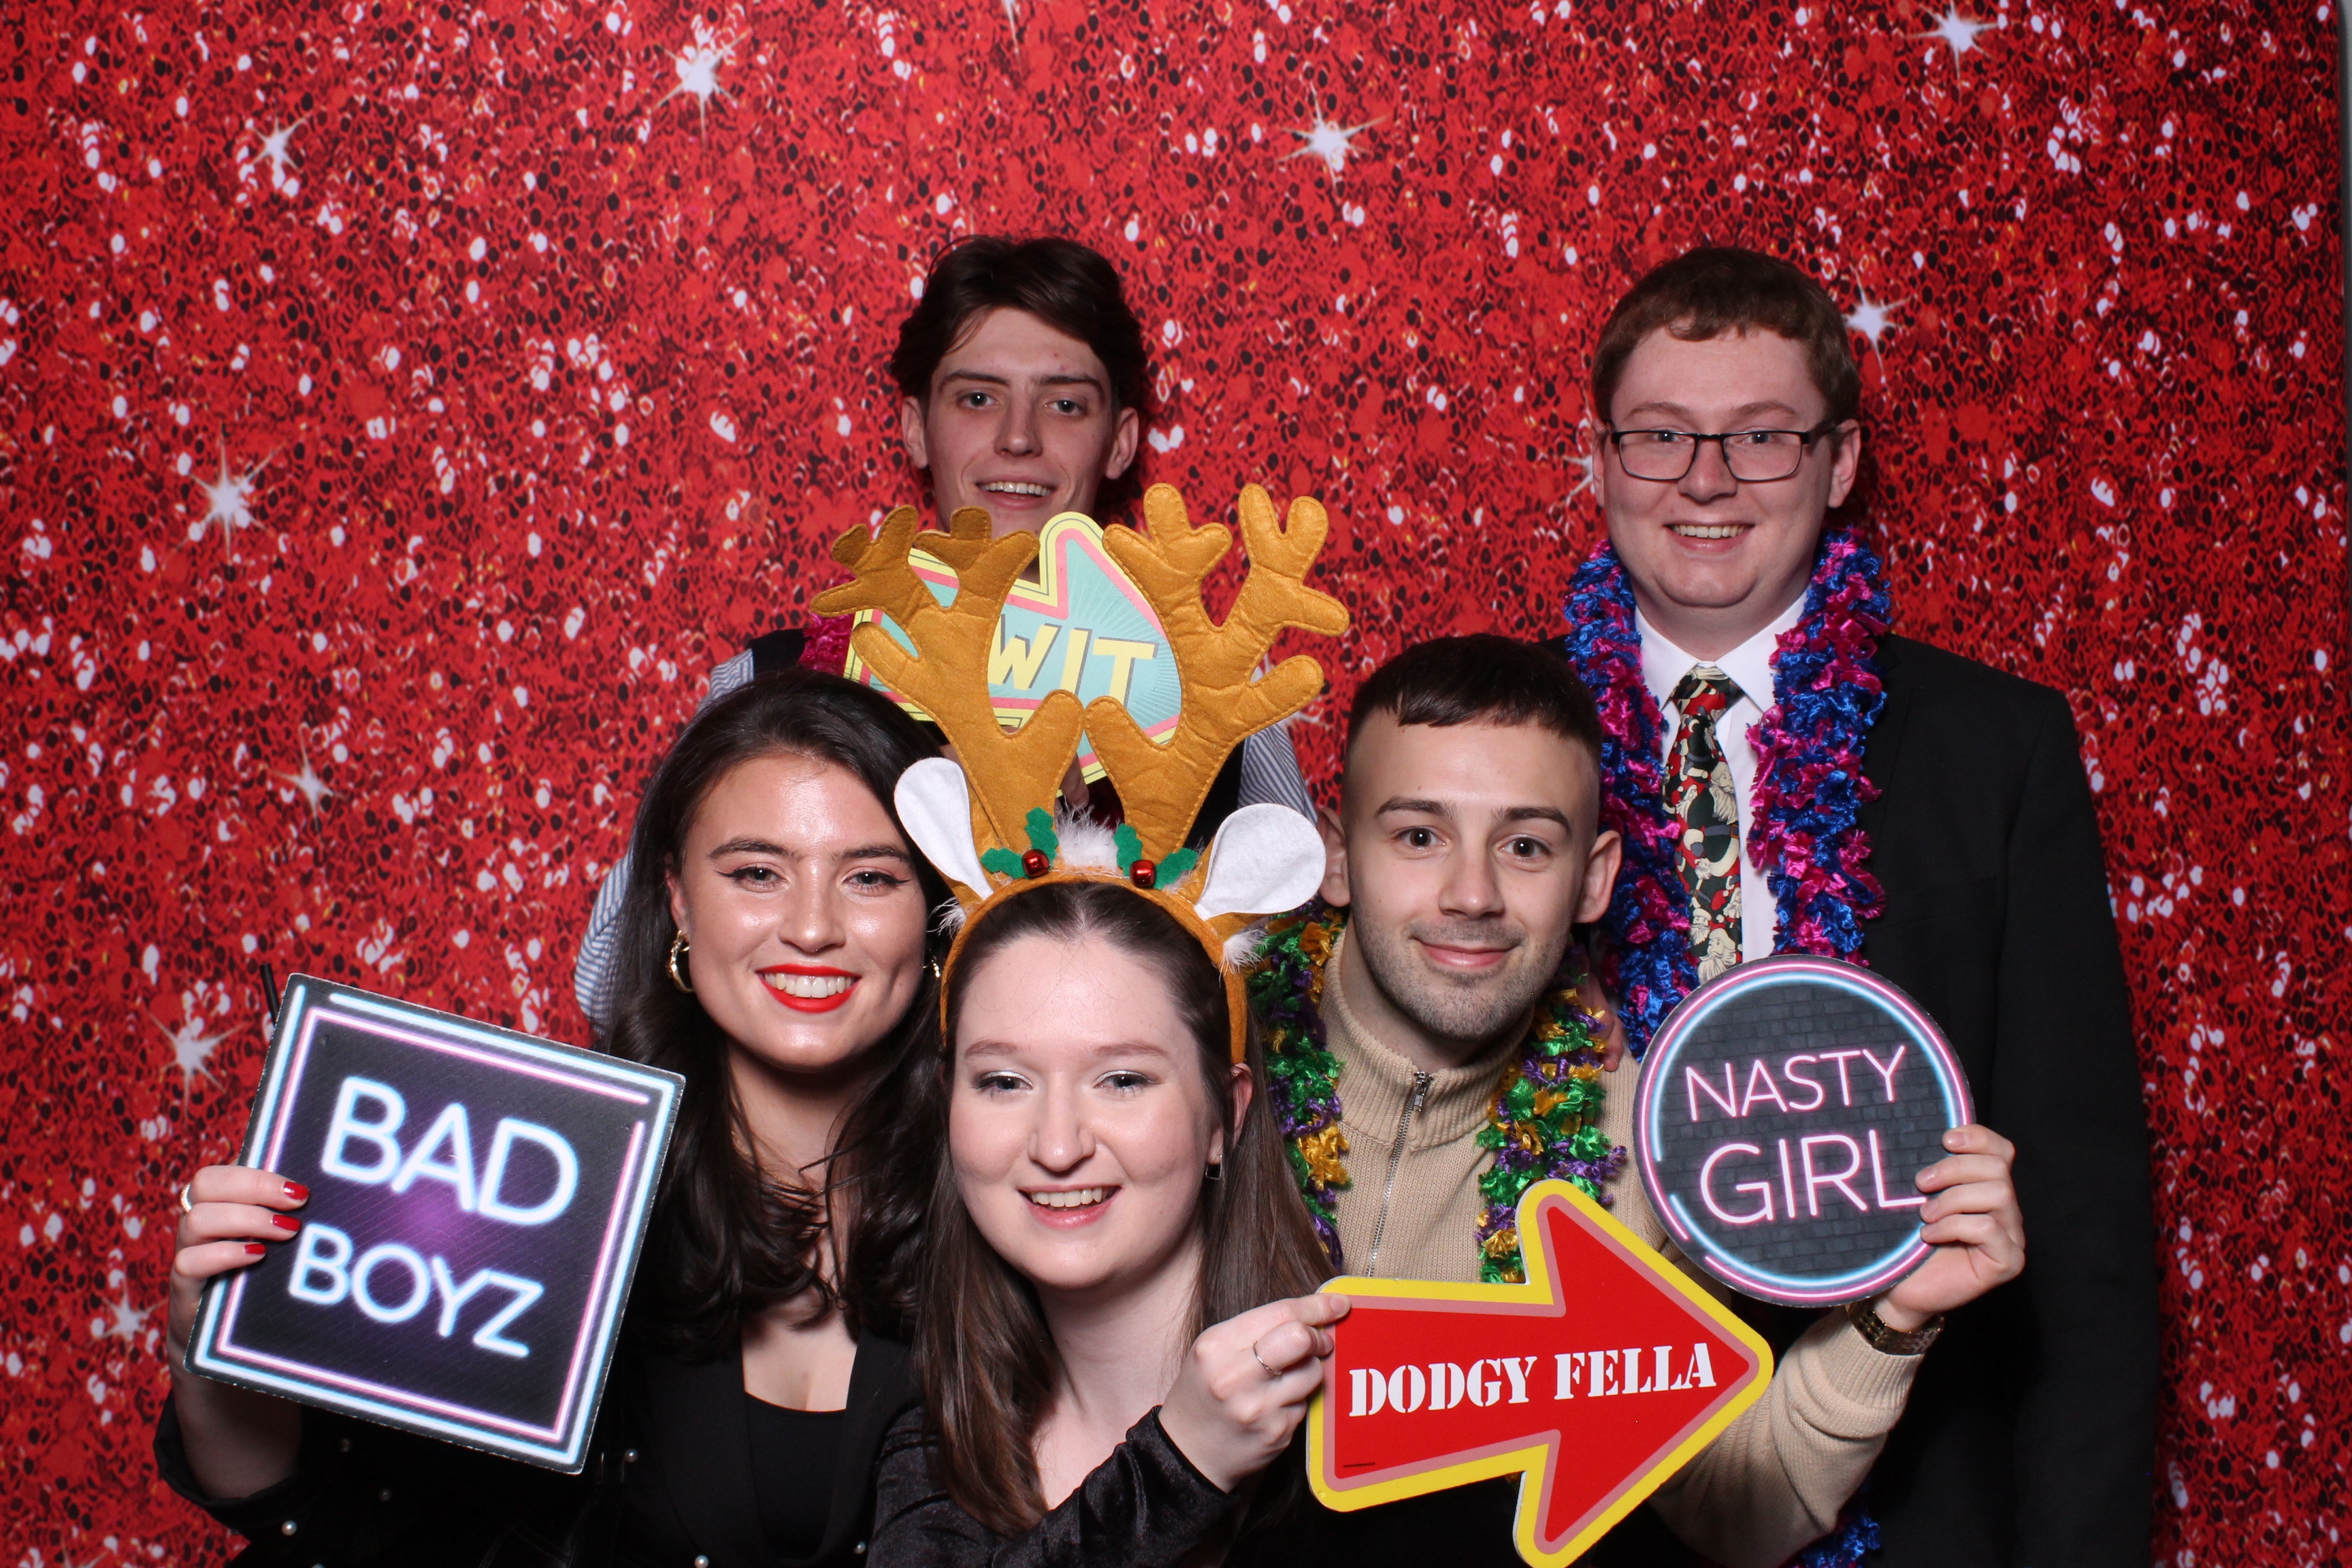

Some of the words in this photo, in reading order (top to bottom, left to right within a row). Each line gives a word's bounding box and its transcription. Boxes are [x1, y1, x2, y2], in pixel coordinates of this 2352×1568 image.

[987, 613, 1160, 709] WIT
[1684, 1044, 1907, 1123] NASTY
[320, 1074, 580, 1225] BAD
[1700, 1128, 1927, 1225] GIRL
[287, 1222, 544, 1358] BOYZ
[1348, 1355, 1537, 1417] DODGY
[1554, 1342, 1716, 1401] FELLA
